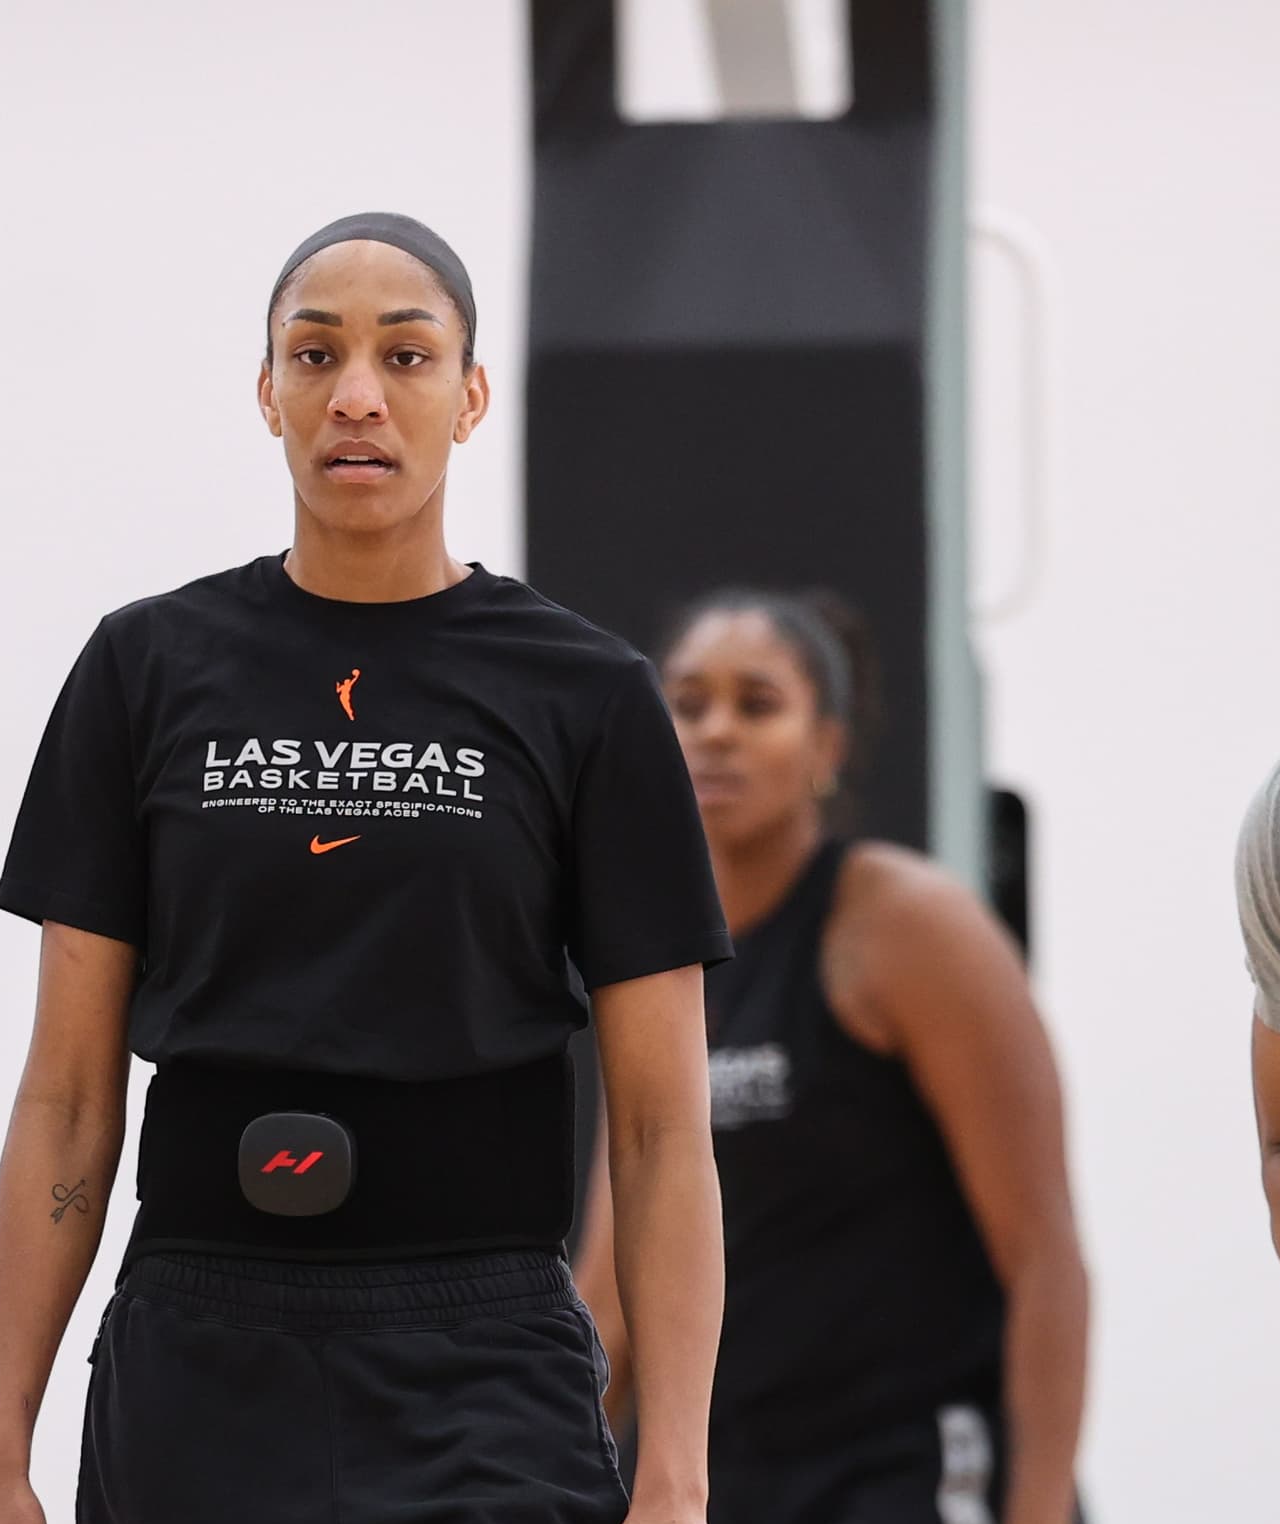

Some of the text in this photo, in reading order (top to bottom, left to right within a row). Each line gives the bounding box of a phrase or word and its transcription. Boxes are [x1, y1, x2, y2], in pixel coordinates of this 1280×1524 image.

[204, 738, 486, 778] LAS VEGAS
[203, 768, 484, 801] BASKETBALL
[202, 797, 483, 819] ENGINEERED TO THE EXACT SPECIFICATIONS
[258, 805, 420, 818] OF THE LAS VEGAS ACES
